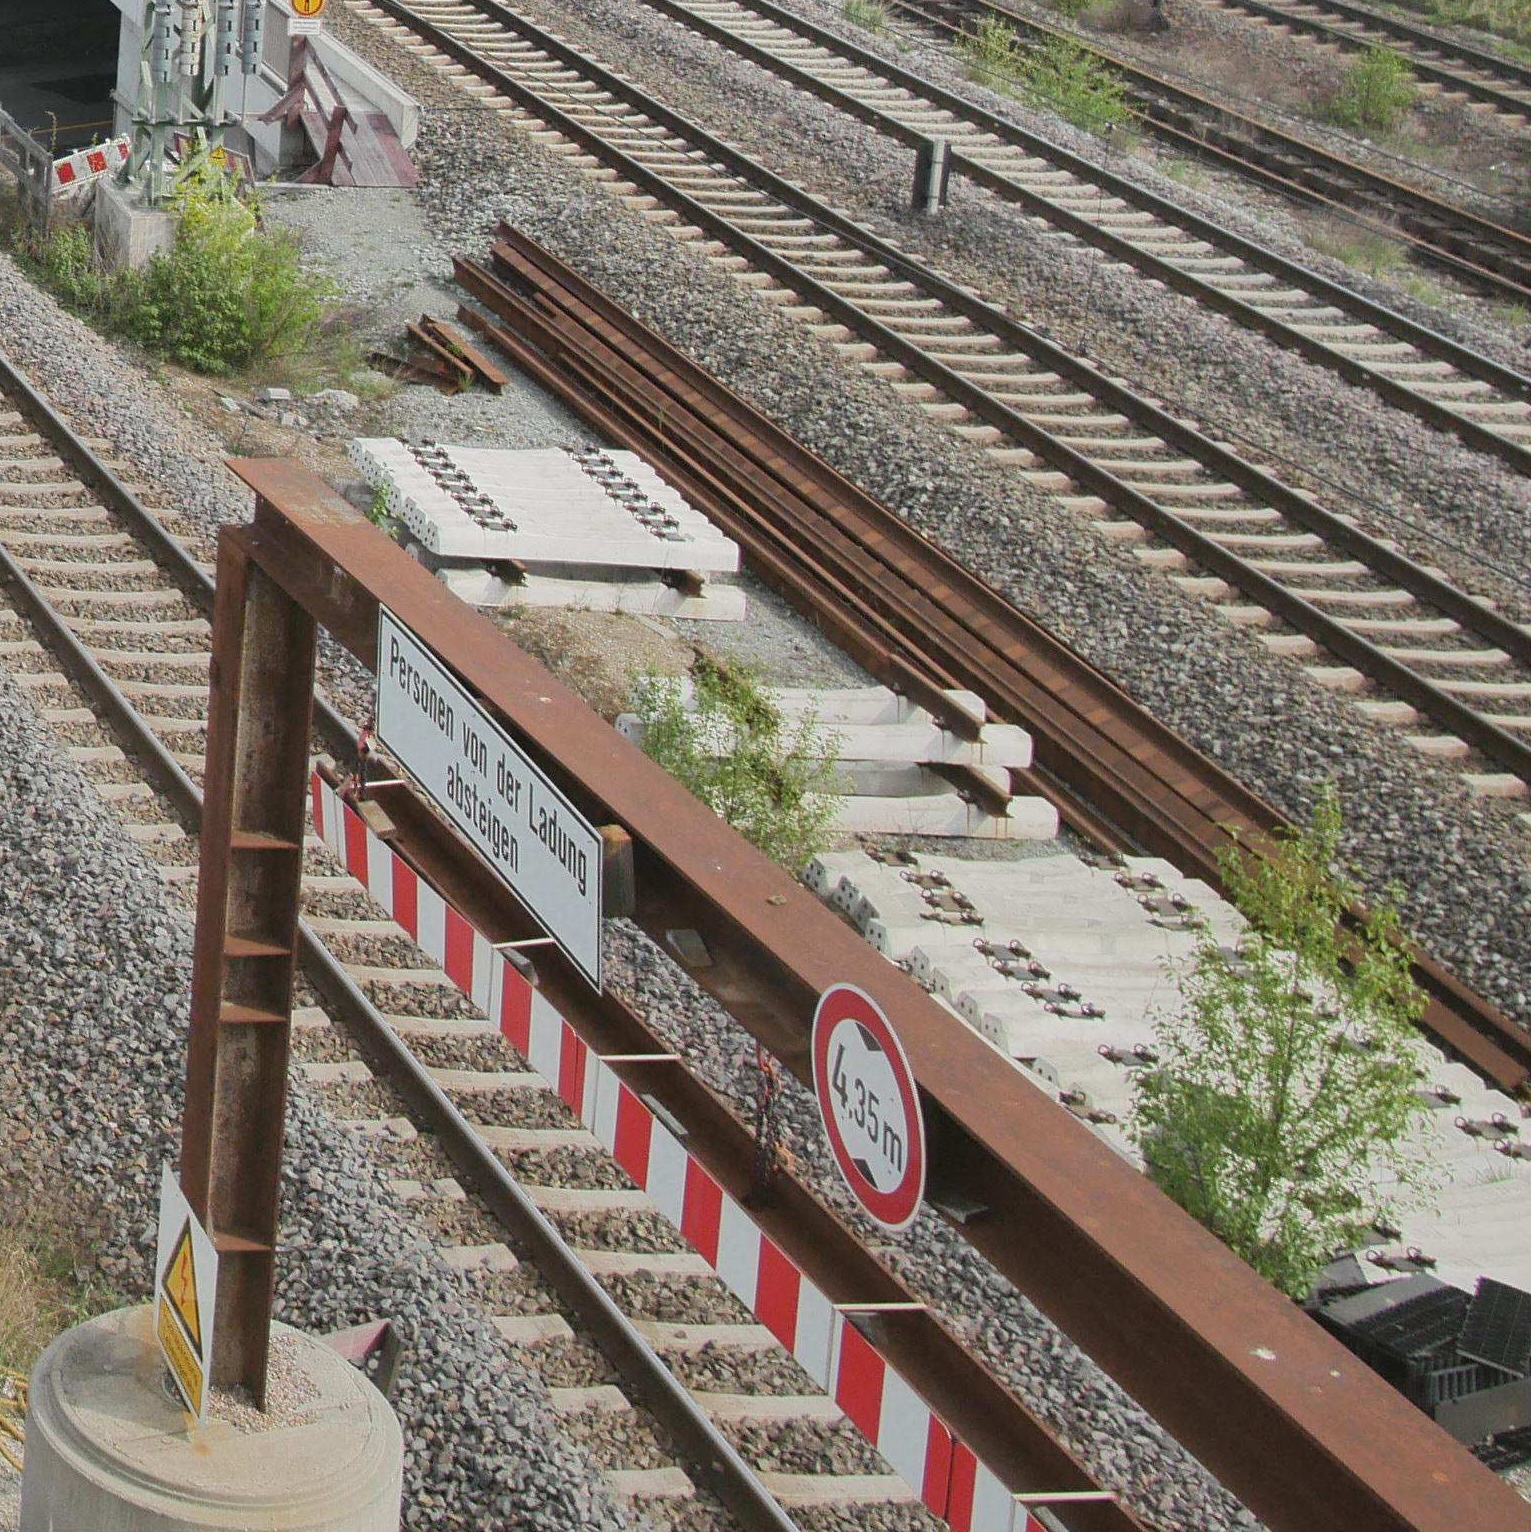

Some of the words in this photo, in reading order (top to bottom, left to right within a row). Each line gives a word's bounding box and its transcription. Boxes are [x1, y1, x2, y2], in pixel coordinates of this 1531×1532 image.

[390, 635, 454, 741] Personen
[462, 721, 487, 778] von
[496, 753, 521, 813] der
[529, 782, 587, 896] Ladung
[446, 762, 519, 874] absteigen
